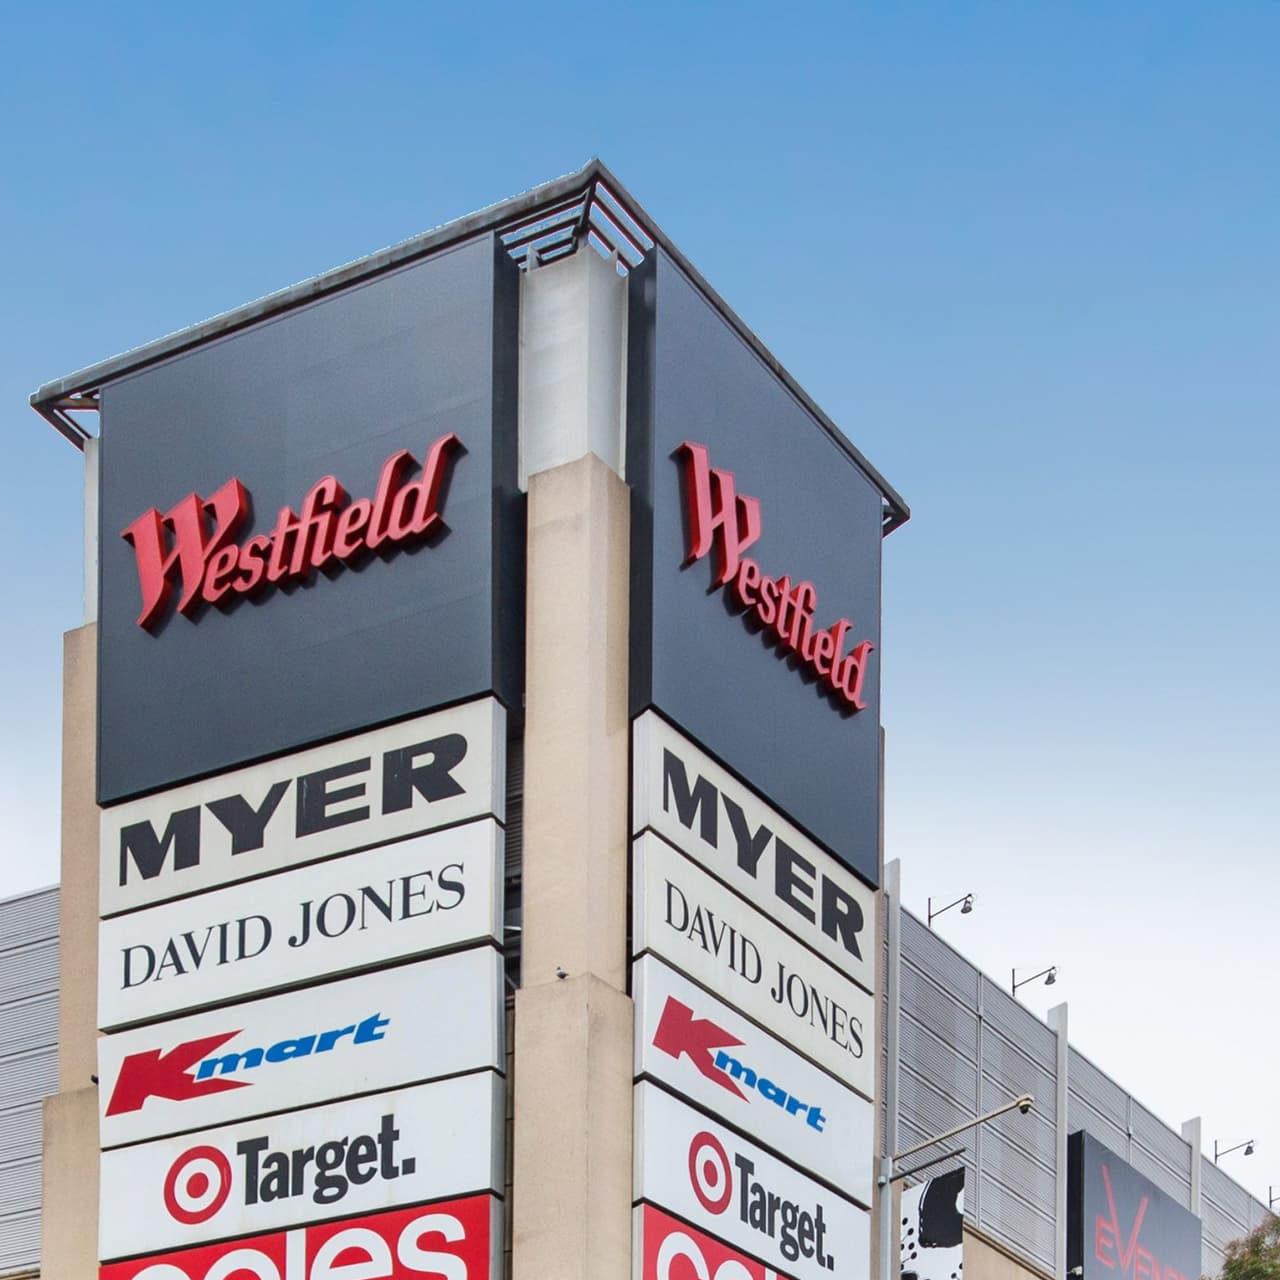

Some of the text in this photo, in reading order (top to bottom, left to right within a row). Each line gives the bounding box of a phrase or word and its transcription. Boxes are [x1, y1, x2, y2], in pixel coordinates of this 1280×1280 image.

[122, 432, 462, 630] Westfield
[676, 441, 874, 710] Westfield
[119, 733, 468, 886] MYER
[663, 747, 865, 963] MYER
[122, 863, 465, 990] DAVID JONES
[665, 879, 864, 1060] DAVID JONES
[105, 1012, 391, 1117] Kmart
[652, 995, 827, 1133] Kmart
